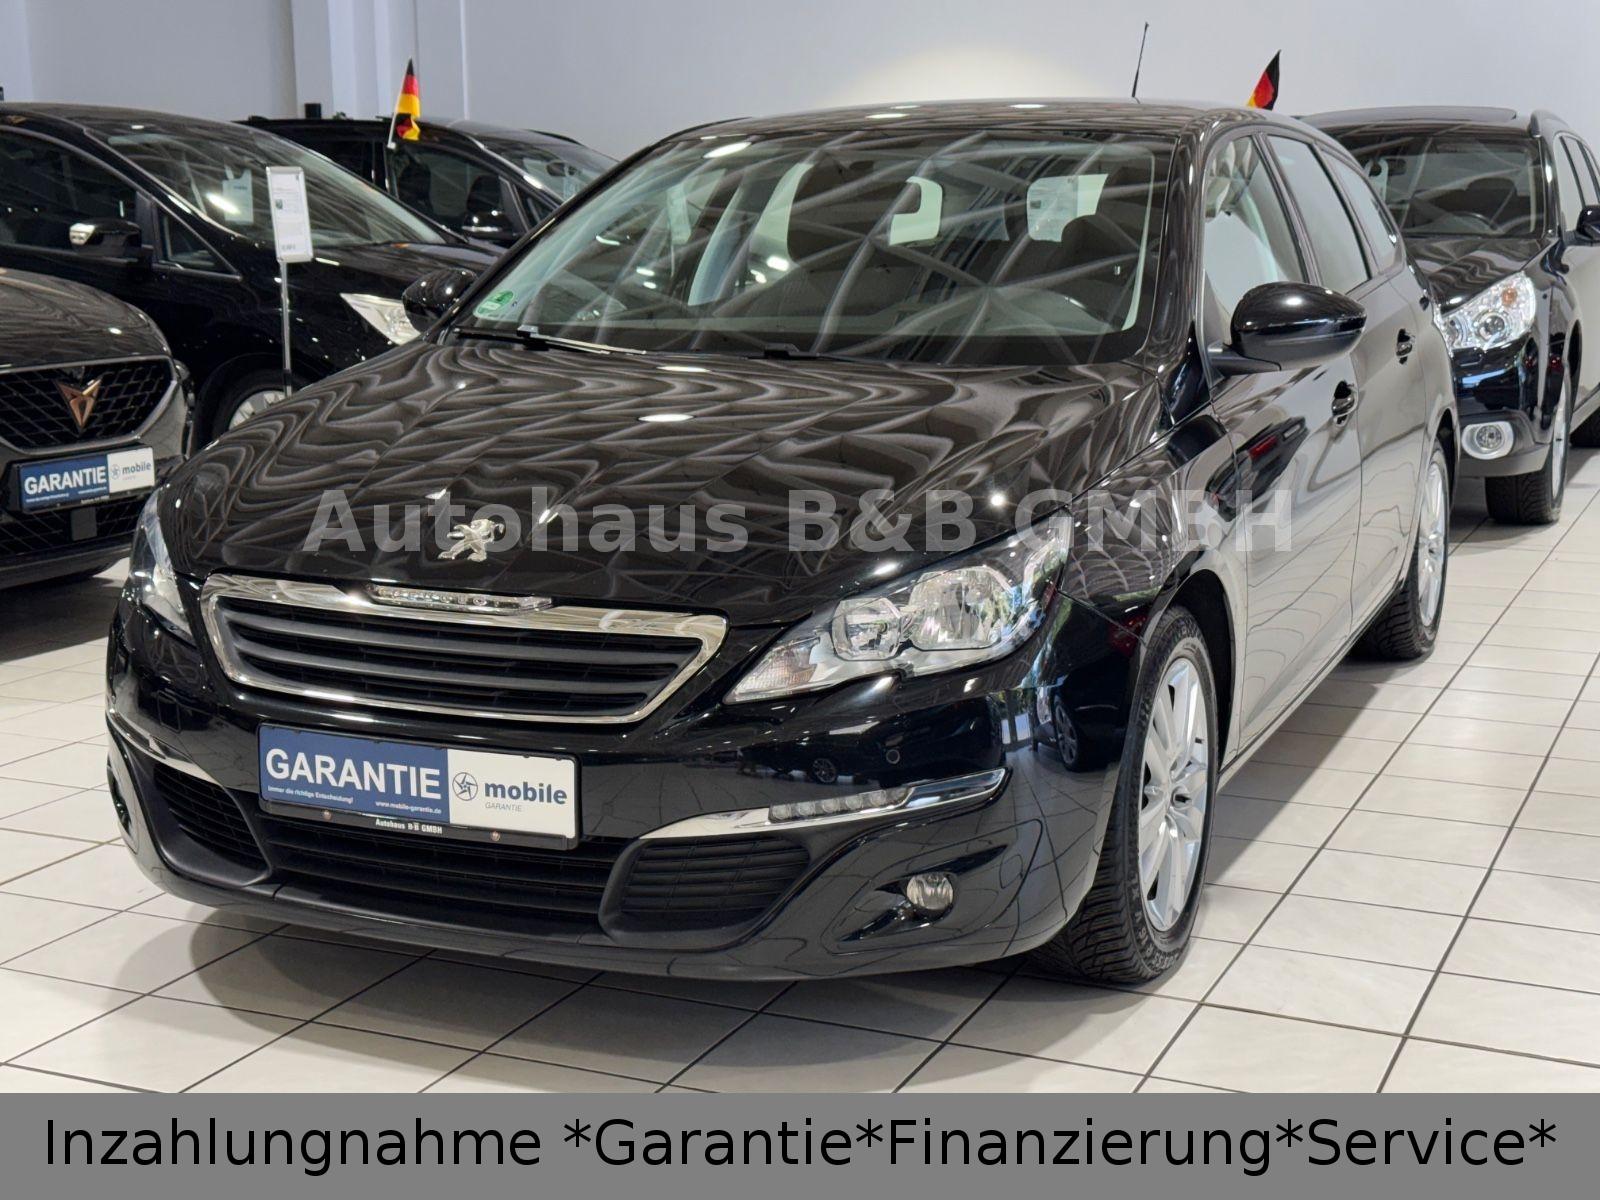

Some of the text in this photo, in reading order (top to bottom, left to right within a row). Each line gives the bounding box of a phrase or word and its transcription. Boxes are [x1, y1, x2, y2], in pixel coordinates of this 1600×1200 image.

[122, 460, 152, 475] mobile
[24, 466, 107, 495] GARANTIE
[265, 748, 442, 800] GARANTIE
[294, 789, 314, 798] richtige
[484, 781, 568, 805] mobile
[375, 801, 442, 814] www.mobile-garantie.de
[485, 801, 522, 812] GARANTIE
[375, 818, 405, 830] Autohaus
[421, 824, 443, 835] GMBH
